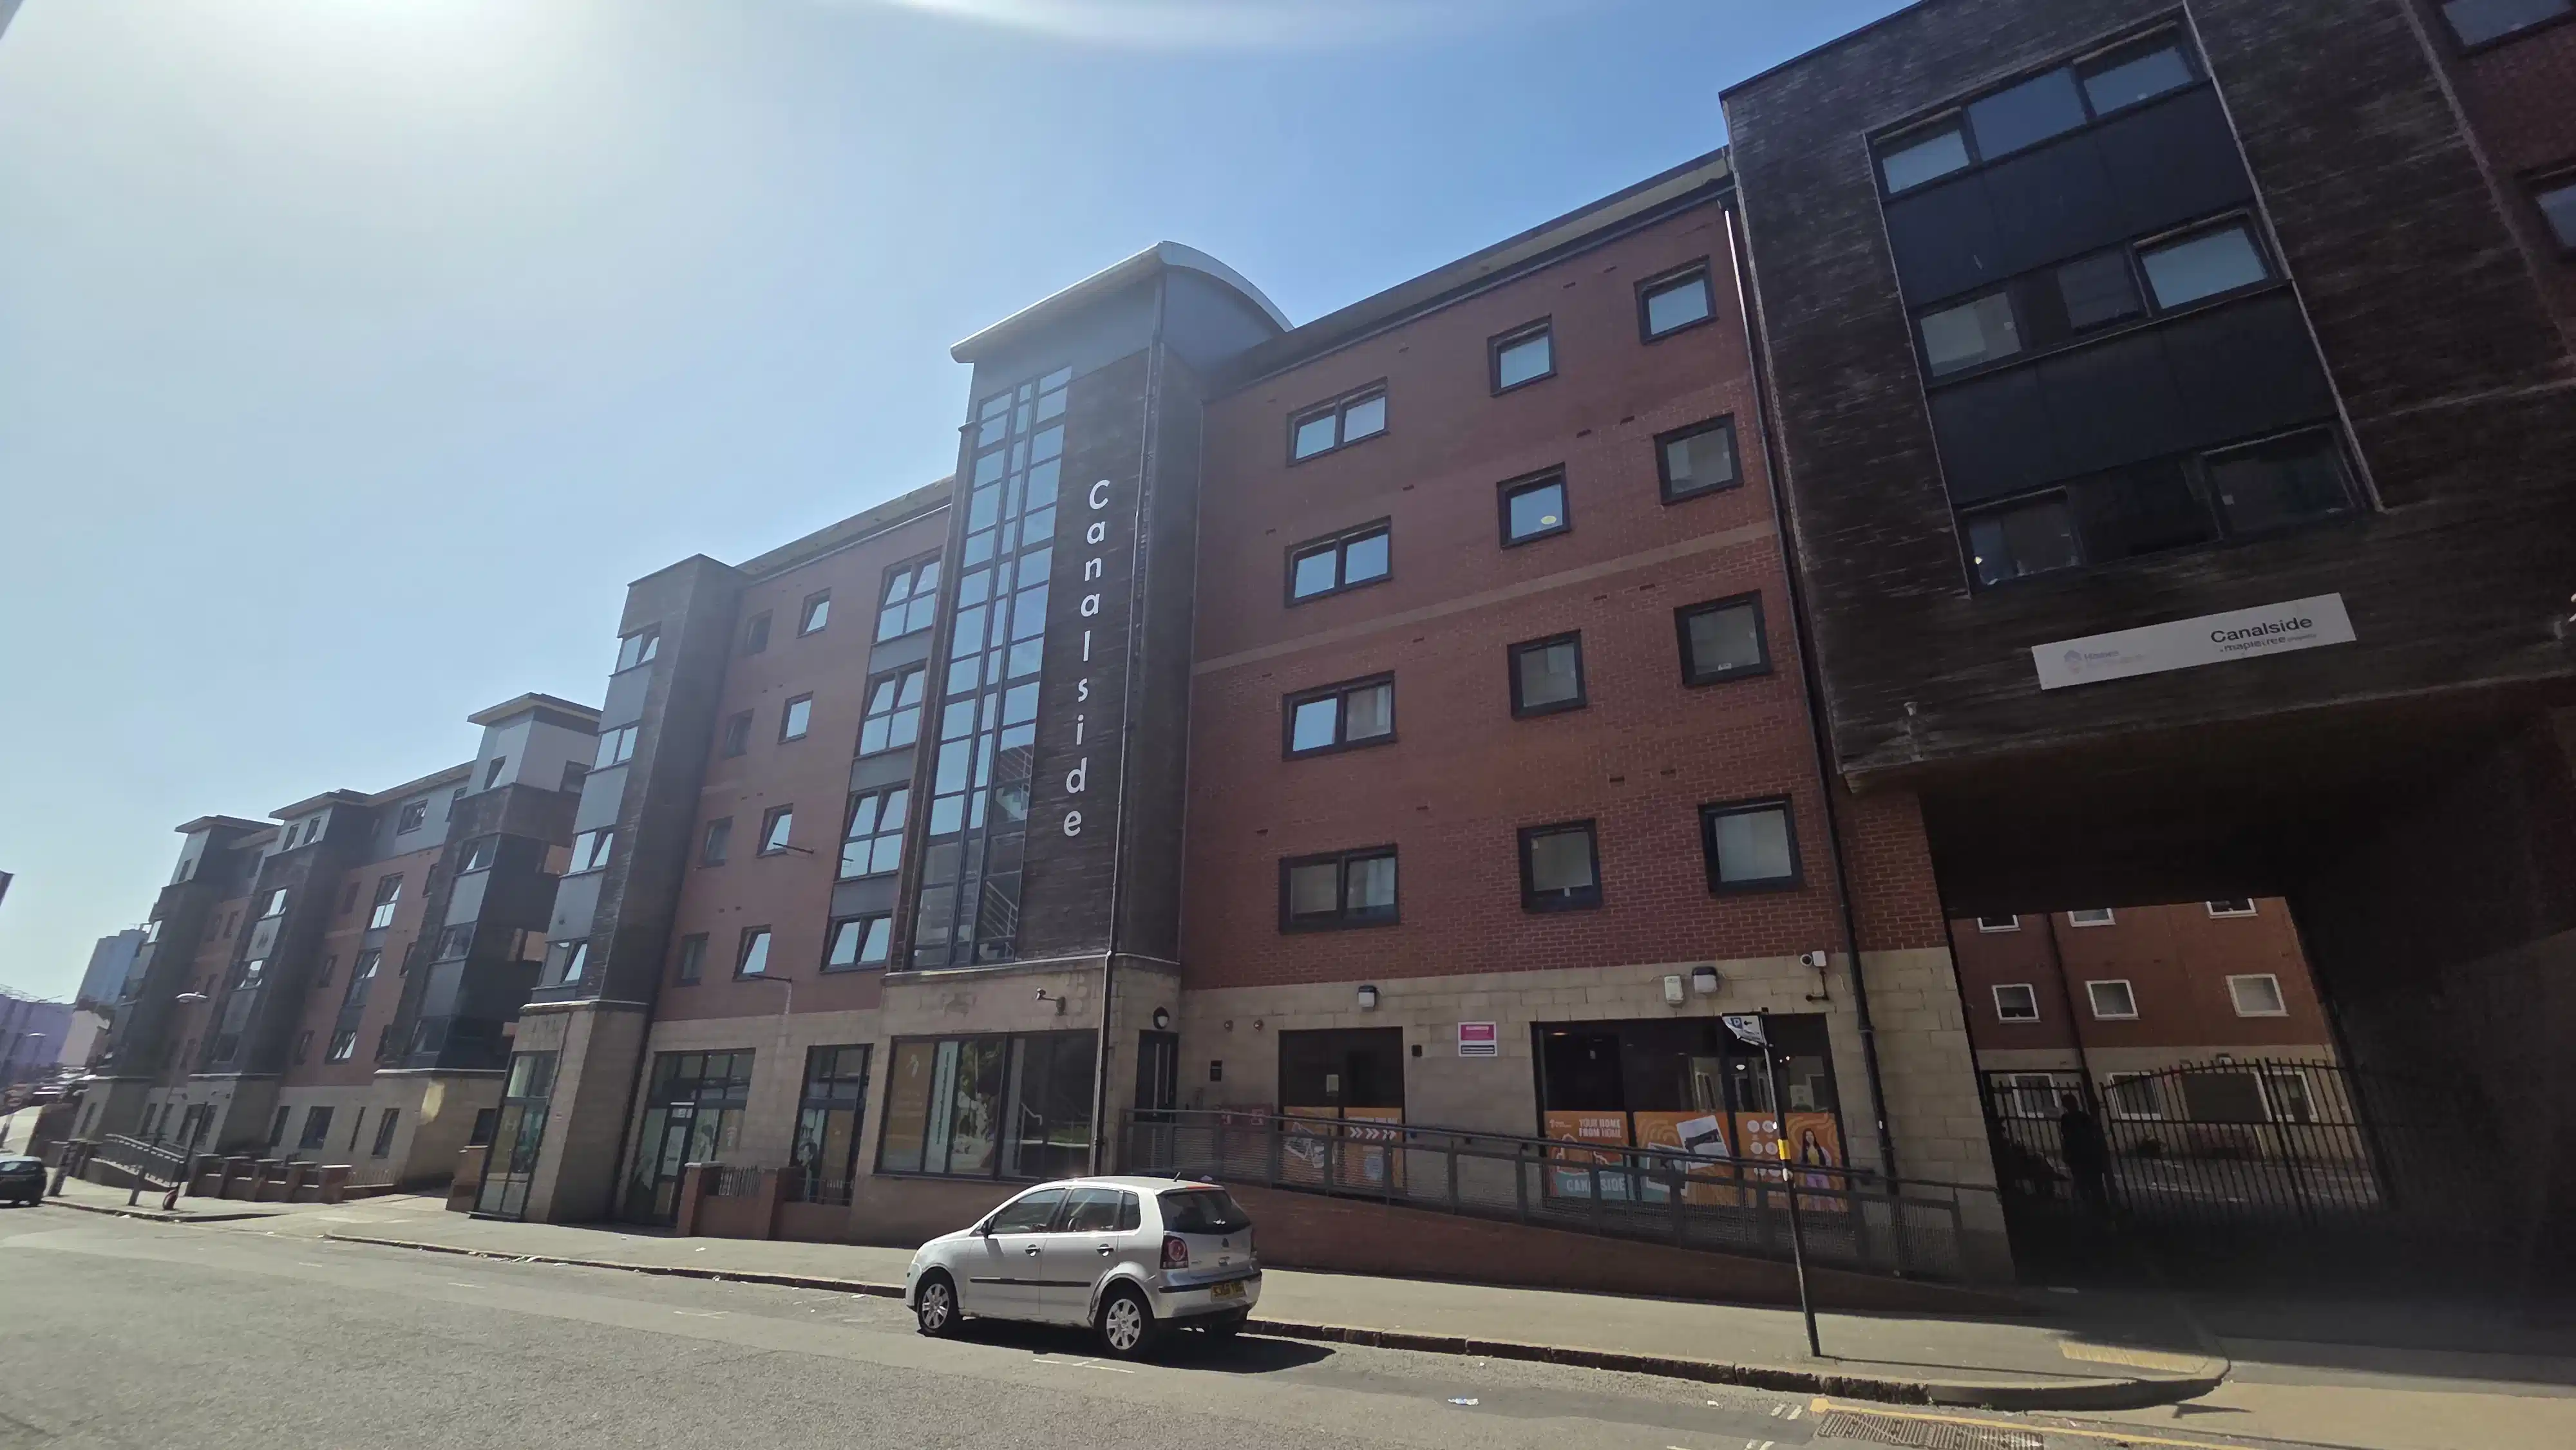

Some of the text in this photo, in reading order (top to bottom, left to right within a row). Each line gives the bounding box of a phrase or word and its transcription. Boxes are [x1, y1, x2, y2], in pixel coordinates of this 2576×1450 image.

[2211, 617, 2313, 643] Canalside
[1064, 480, 1110, 836] Canalside
[1579, 1118, 1597, 1127] YOUR
[1600, 1118, 1621, 1128] HOME
[1579, 1128, 1600, 1137] FROM
[1566, 1178, 1625, 1191] CANSIDE
